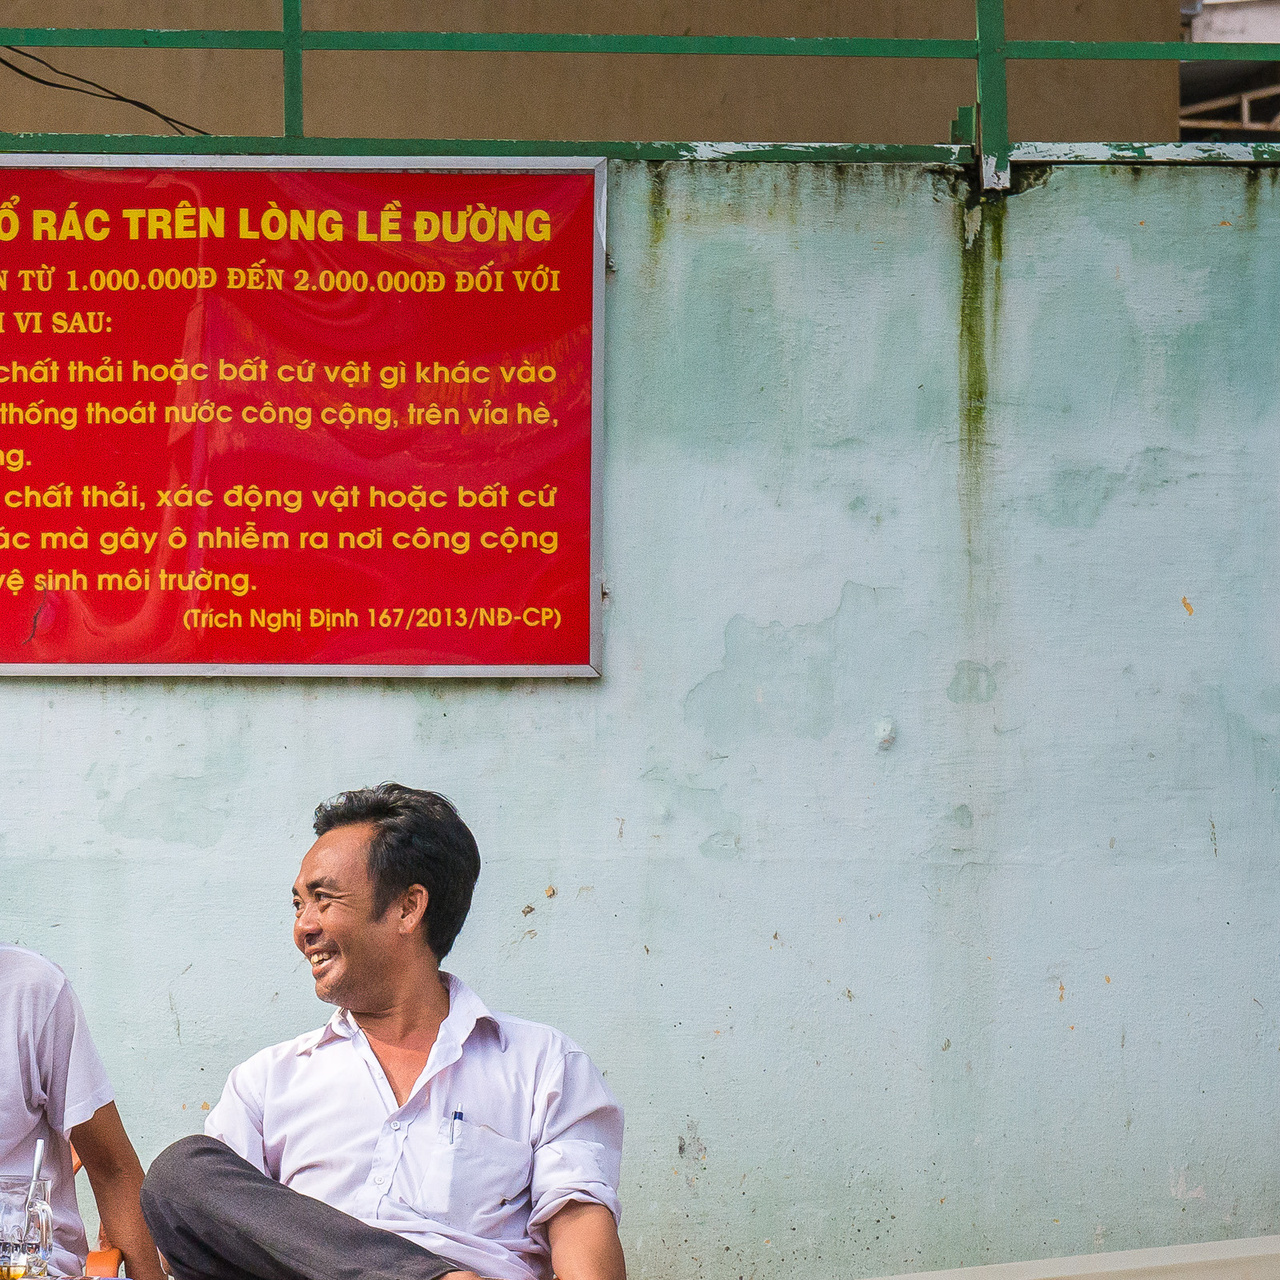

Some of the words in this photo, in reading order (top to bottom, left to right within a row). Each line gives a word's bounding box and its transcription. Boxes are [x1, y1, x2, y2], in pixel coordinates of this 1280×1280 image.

[32, 201, 111, 242] RÁC
[122, 200, 225, 240] TRÊN
[239, 201, 344, 242] LÒNG
[357, 200, 402, 242] LỀ
[413, 202, 551, 243] ĐƯỜNG
[17, 263, 56, 292] TỪ
[68, 266, 217, 292] 1.000.000Đ
[226, 258, 285, 290] ĐẾN
[294, 269, 446, 293] 2.000.000Đ
[455, 260, 503, 293] ĐỐI
[512, 264, 560, 292] VỚI
[13, 312, 43, 334] VI
[51, 311, 112, 334] SAU:
[67, 356, 123, 383] thải
[132, 358, 208, 386] hoặc
[218, 356, 269, 382] bất
[276, 359, 316, 383] cứ
[324, 360, 371, 388] vật
[379, 360, 406, 390] gì
[416, 360, 490, 384] khác
[499, 359, 557, 383] vào
[0, 399, 78, 431] thống
[85, 400, 157, 425] thoát
[164, 399, 232, 424] nước
[241, 401, 312, 430] công
[320, 402, 399, 431] cộng,
[407, 402, 460, 426] trên
[468, 399, 508, 425] vỉa
[517, 401, 558, 428] hè,
[4, 482, 74, 508] chất
[81, 480, 146, 511] thải,
[156, 483, 213, 508] xác
[223, 484, 303, 514] động
[311, 485, 361, 513] vật
[369, 485, 447, 512] hoặc
[458, 482, 509, 508] bất
[517, 483, 558, 508] cứ
[40, 526, 89, 550] mà
[99, 526, 158, 556] gây
[167, 526, 187, 549] ô
[197, 521, 289, 550] nhiễm
[299, 531, 329, 550] ra
[338, 527, 383, 550] nơi
[392, 526, 470, 555] công
[480, 526, 558, 555] cộng
[34, 568, 88, 592] sinh
[97, 568, 150, 591] môi
[158, 567, 257, 597] trường.
[183, 608, 243, 631] (Trích
[250, 608, 302, 633] Nghị
[309, 608, 359, 632] Định
[368, 607, 562, 630] 167/2013/NĐ-CP)
